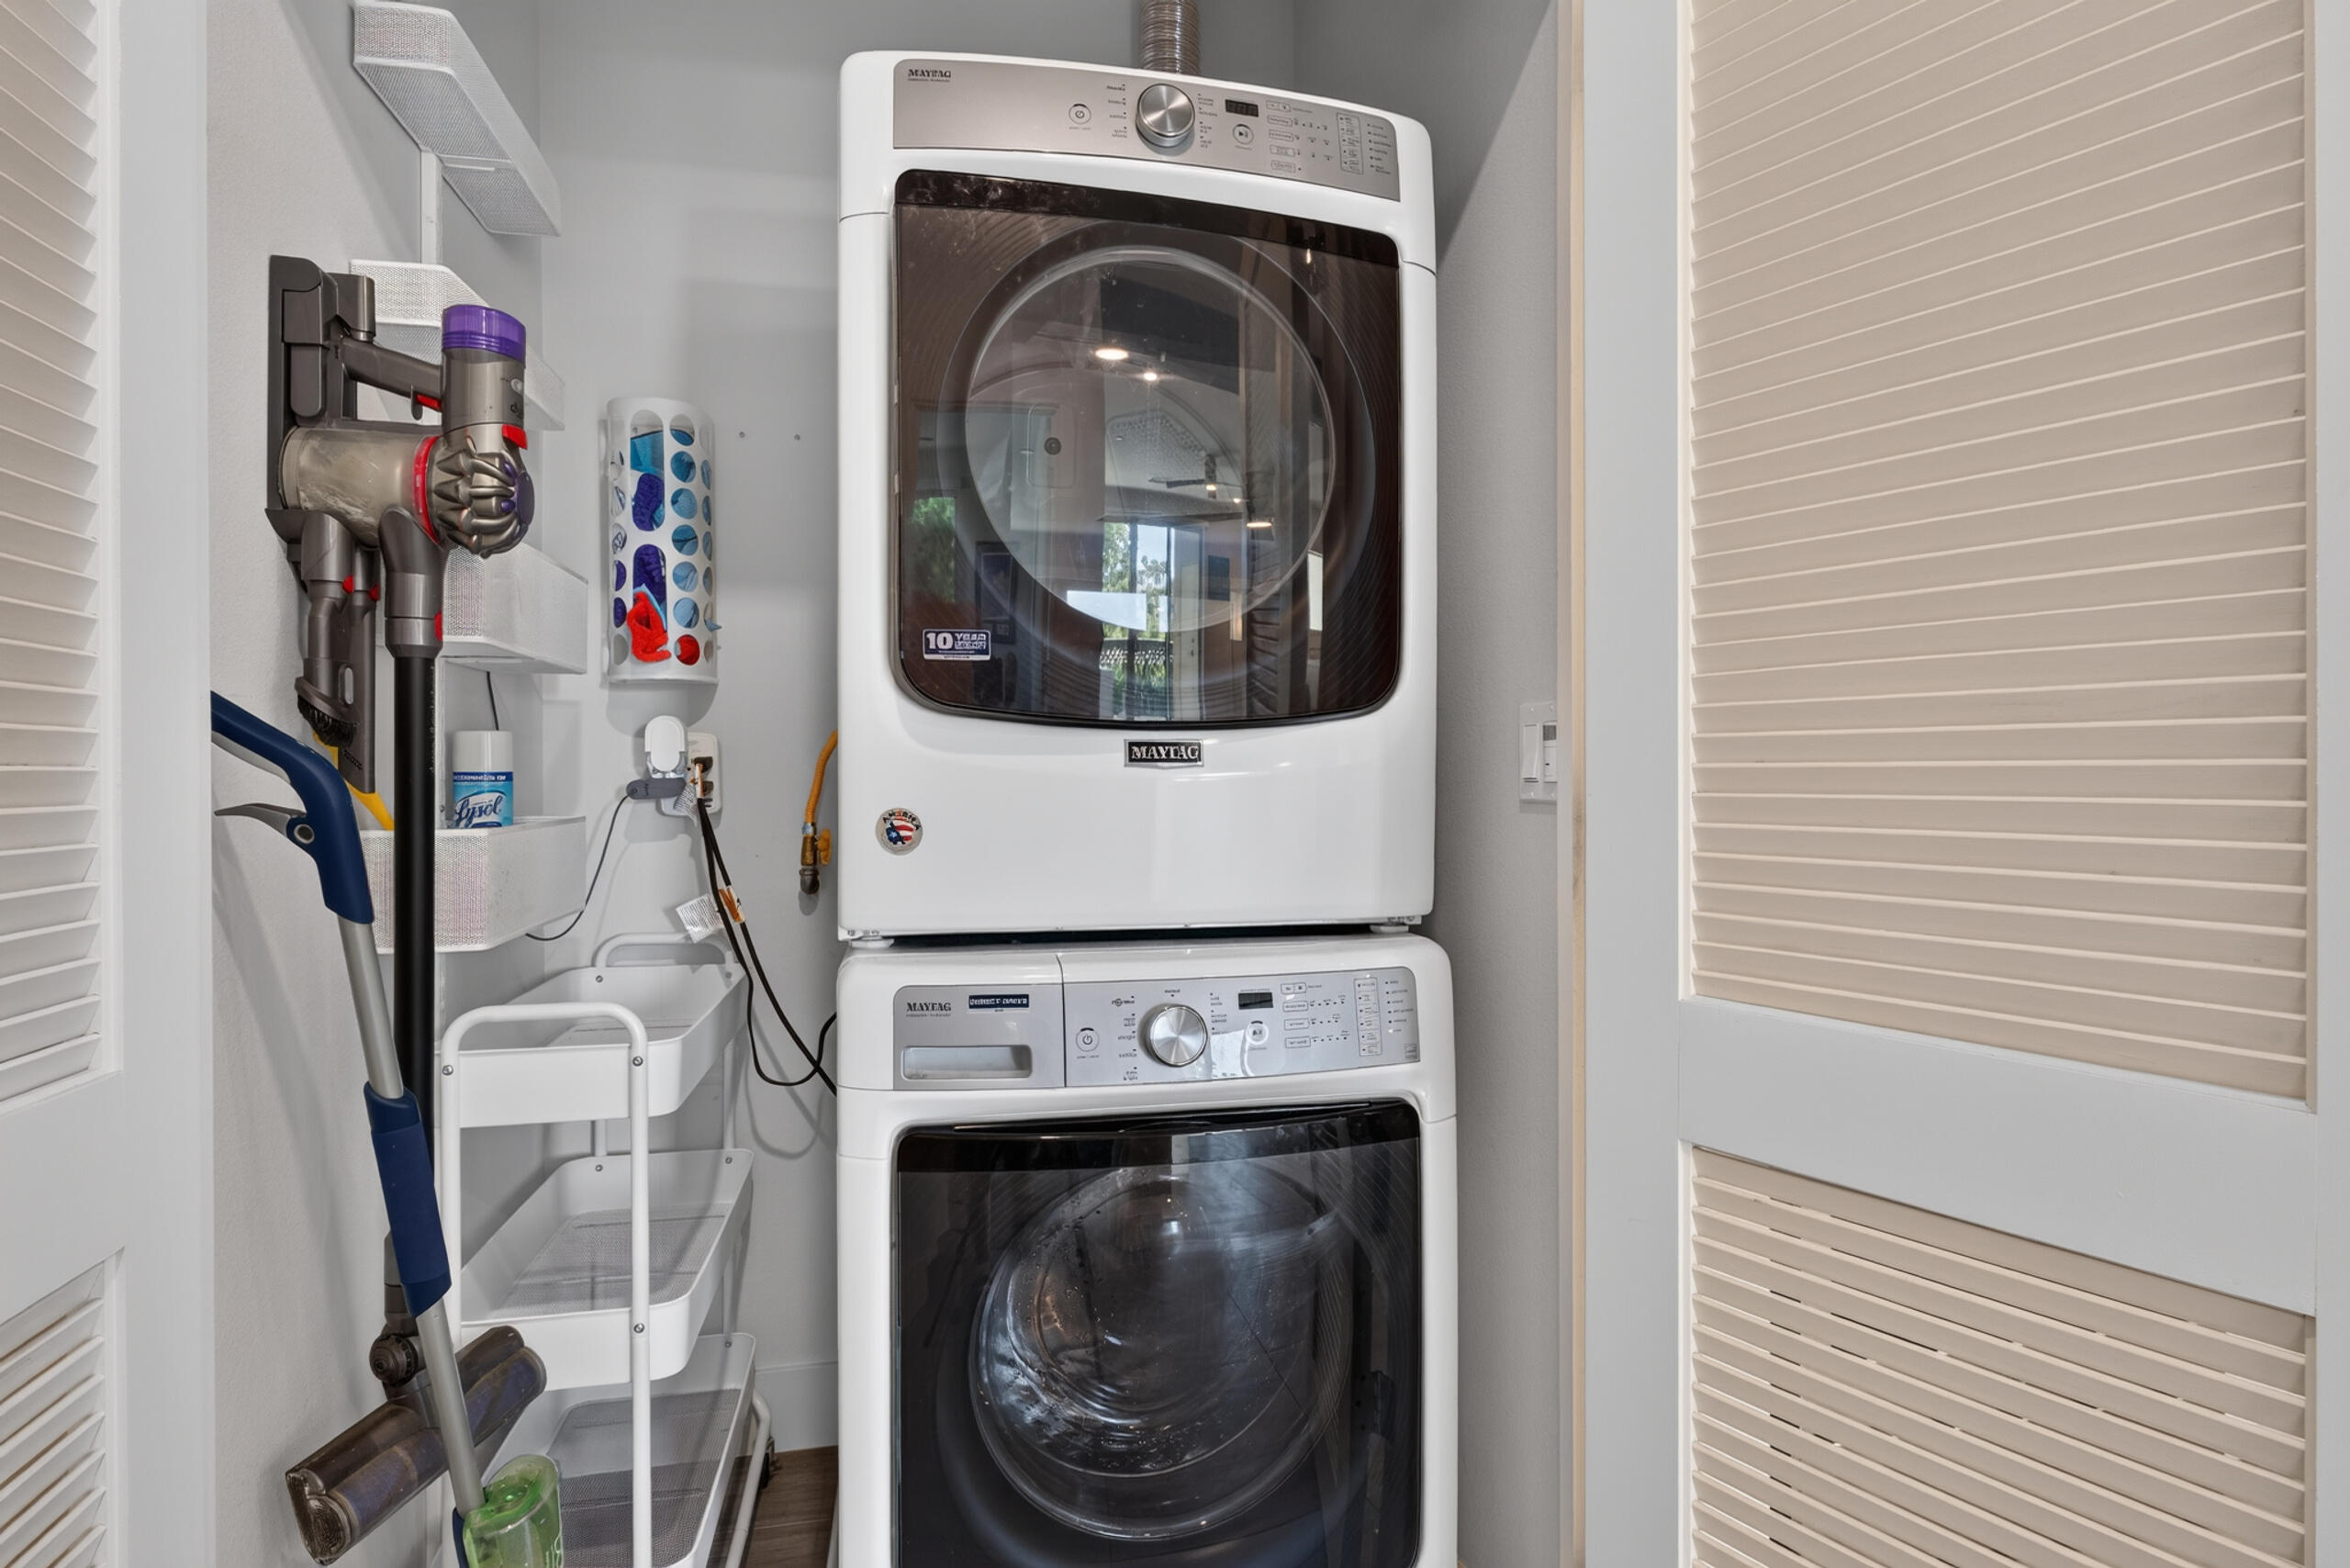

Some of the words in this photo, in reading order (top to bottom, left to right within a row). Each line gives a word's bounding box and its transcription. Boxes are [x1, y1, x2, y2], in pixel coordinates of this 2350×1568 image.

[908, 69, 951, 78] MAYTAG
[926, 633, 954, 649] 10
[1131, 745, 1199, 759] MAYTAG
[455, 794, 503, 829] Lysol
[907, 1002, 951, 1012] MAYTAG
